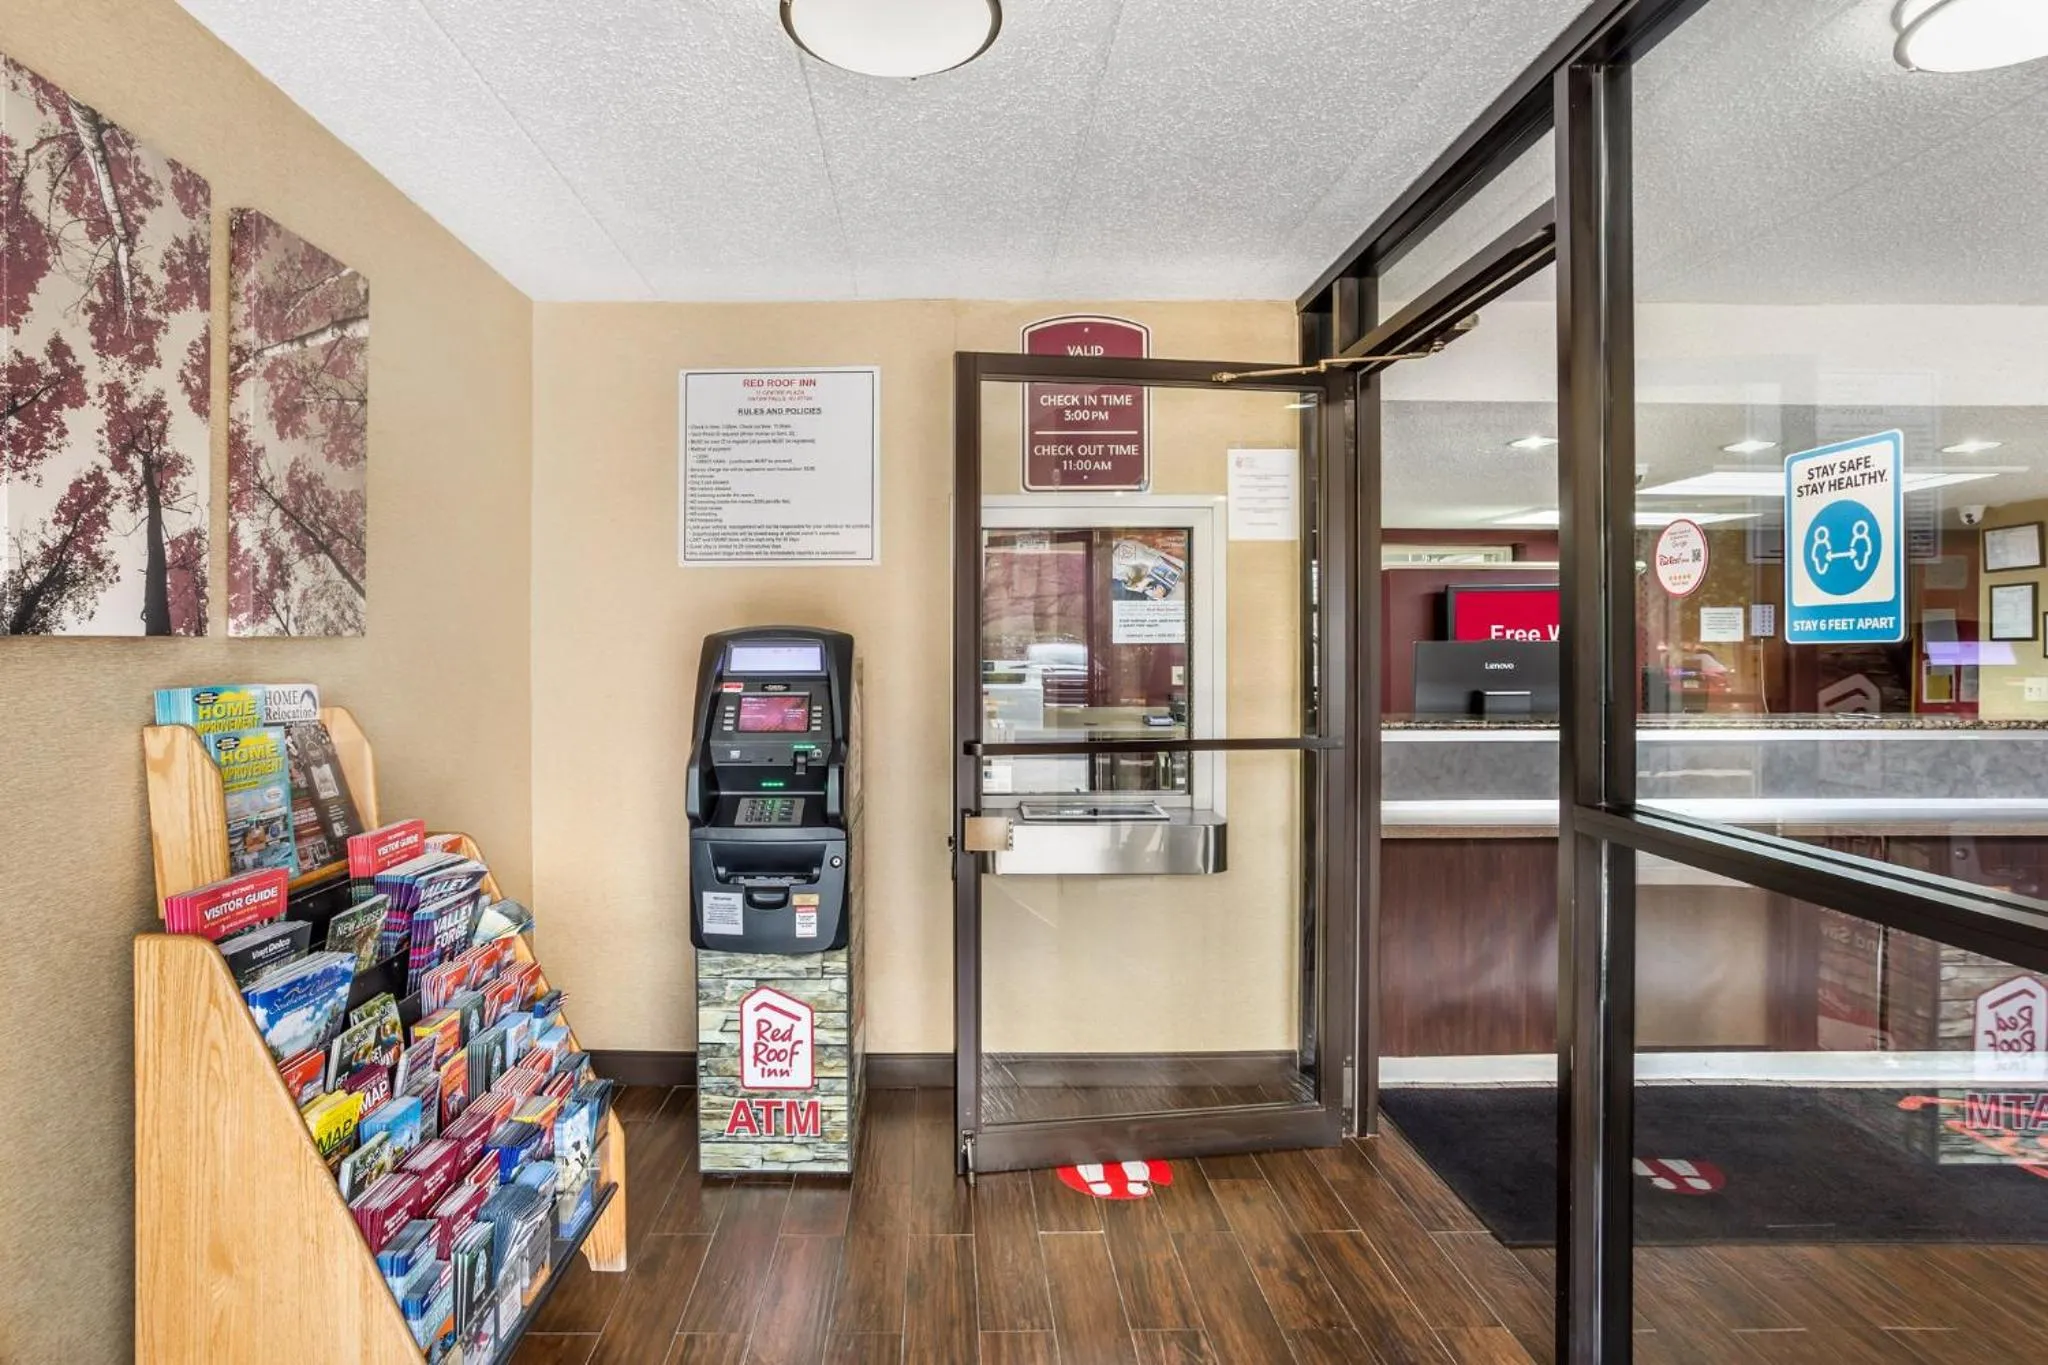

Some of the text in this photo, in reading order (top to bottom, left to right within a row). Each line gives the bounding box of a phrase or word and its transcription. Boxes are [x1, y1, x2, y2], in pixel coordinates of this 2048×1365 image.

[1067, 345, 1104, 357] VALID
[743, 378, 816, 387] RED ROOF INN
[1040, 395, 1132, 406] CHECK IN TIME
[738, 408, 764, 416] RULES
[766, 408, 783, 416] AND
[1064, 411, 1109, 421] 3:00 PM
[1034, 445, 1139, 456] CHECK OUT TIME
[1062, 460, 1112, 471] 11:00 AM
[1807, 455, 1876, 481] STAY SAFE.
[1796, 469, 1889, 499] STAY HEALTHY.
[1490, 624, 1541, 641] Free
[1793, 616, 1896, 632] STAY 6 FEET APART
[1485, 661, 1514, 670] Lenovo
[265, 690, 299, 706] HOME
[199, 700, 257, 720] HOME
[221, 743, 278, 766] HOME
[421, 877, 473, 902] VALLEY
[204, 897, 244, 921] VISITOR
[245, 886, 278, 906] GUIDE
[433, 903, 474, 935] VALLEY
[336, 920, 354, 937] NEW
[434, 922, 468, 952] FORGE
[756, 1019, 794, 1042] Red
[753, 1040, 804, 1067] Roof
[725, 1099, 821, 1137] ATM
[317, 1118, 353, 1154] MAP
